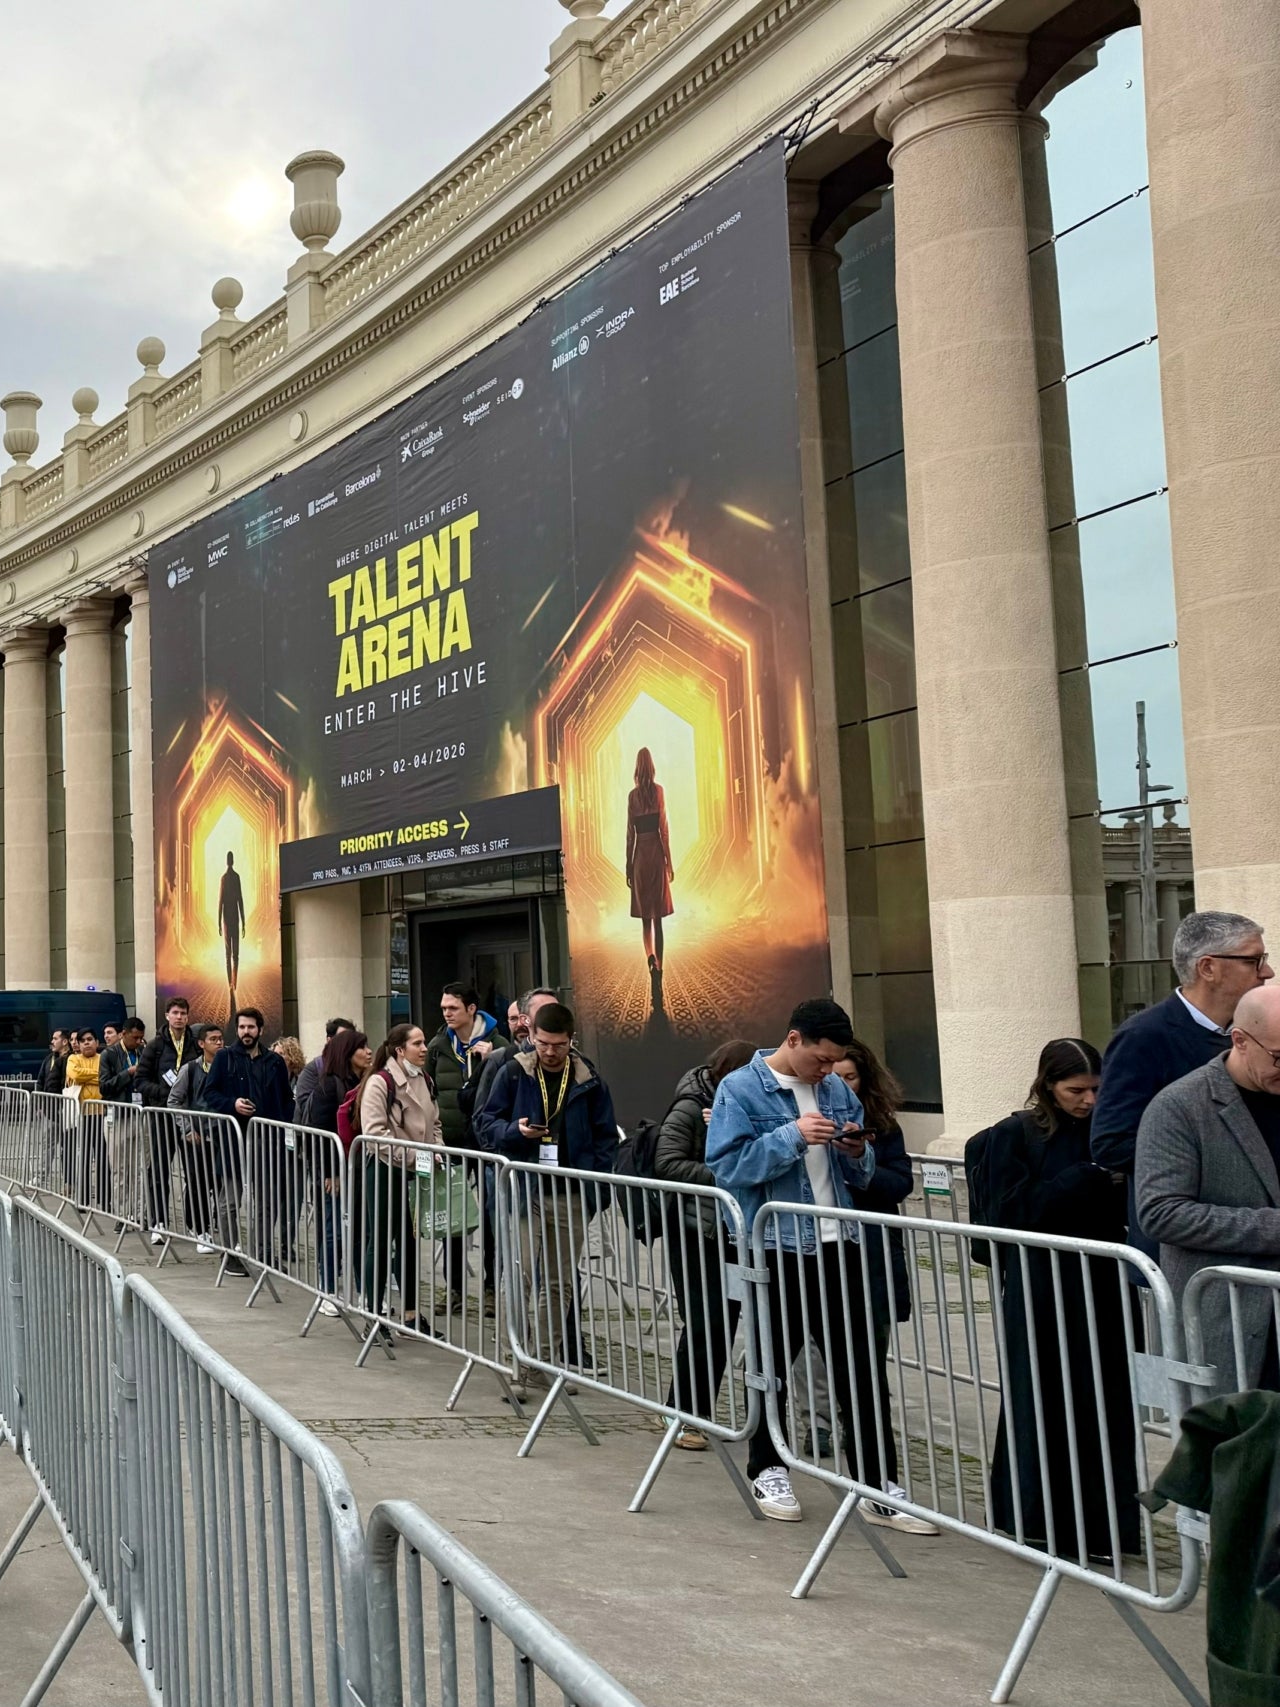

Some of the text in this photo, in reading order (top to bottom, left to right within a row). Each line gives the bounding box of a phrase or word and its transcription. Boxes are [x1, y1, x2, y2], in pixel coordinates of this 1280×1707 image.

[658, 211, 742, 274] TOP EMPLOYABILITY SPONSOR
[659, 278, 680, 306] EAE
[550, 305, 604, 346] SUPPORTING SPONSORS
[605, 307, 635, 331] INDRA
[606, 321, 626, 338] GROUP
[552, 347, 578, 371] Allianz
[462, 377, 497, 405] EVENT SPONSORS
[496, 382, 523, 405] SEIDOR
[463, 401, 491, 423] Schneider
[413, 426, 443, 451] CaixaBank
[345, 472, 376, 497] Barcelona
[336, 493, 468, 568] WHERE DIGITAL TALENT MEETS
[208, 545, 228, 563] MWC
[328, 510, 479, 636] TALENT
[335, 588, 472, 698] ARENA
[324, 661, 487, 735] ENTER THE HIVE
[341, 768, 372, 788] MARCH
[393, 742, 466, 774] 02-04/2026
[339, 819, 448, 855] PRIORITY ACCESS
[325, 868, 339, 879] PASS,
[373, 857, 405, 871] ATTENDEES,
[406, 854, 424, 865] VIPS,
[426, 848, 458, 862] SPEAKERS,
[460, 843, 480, 856] PRESS
[482, 842, 487, 852] &
[489, 838, 510, 850] STAFF
